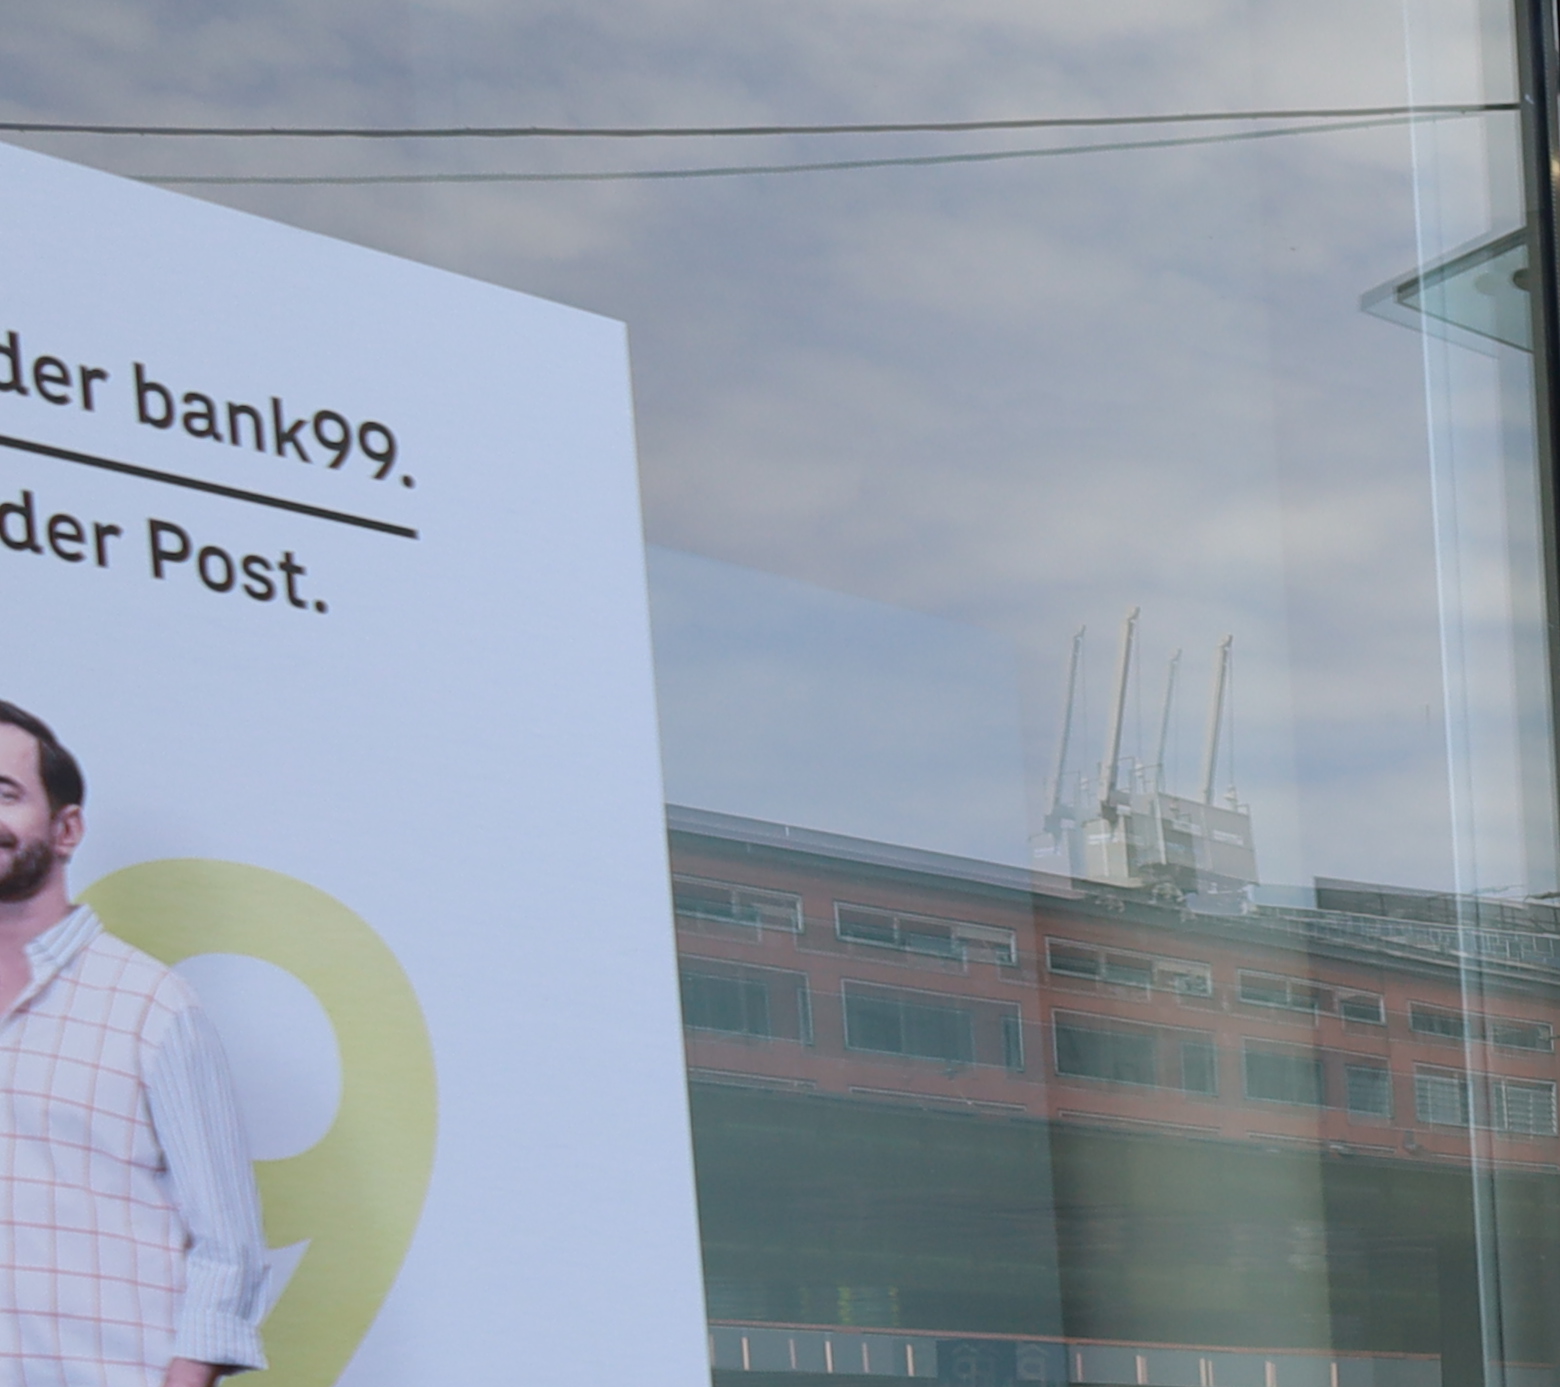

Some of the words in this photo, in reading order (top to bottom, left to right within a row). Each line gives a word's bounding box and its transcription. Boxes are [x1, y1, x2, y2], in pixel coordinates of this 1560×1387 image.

[134, 362, 417, 488] bank99.
[0, 490, 122, 568] der
[149, 518, 329, 613] Post.
